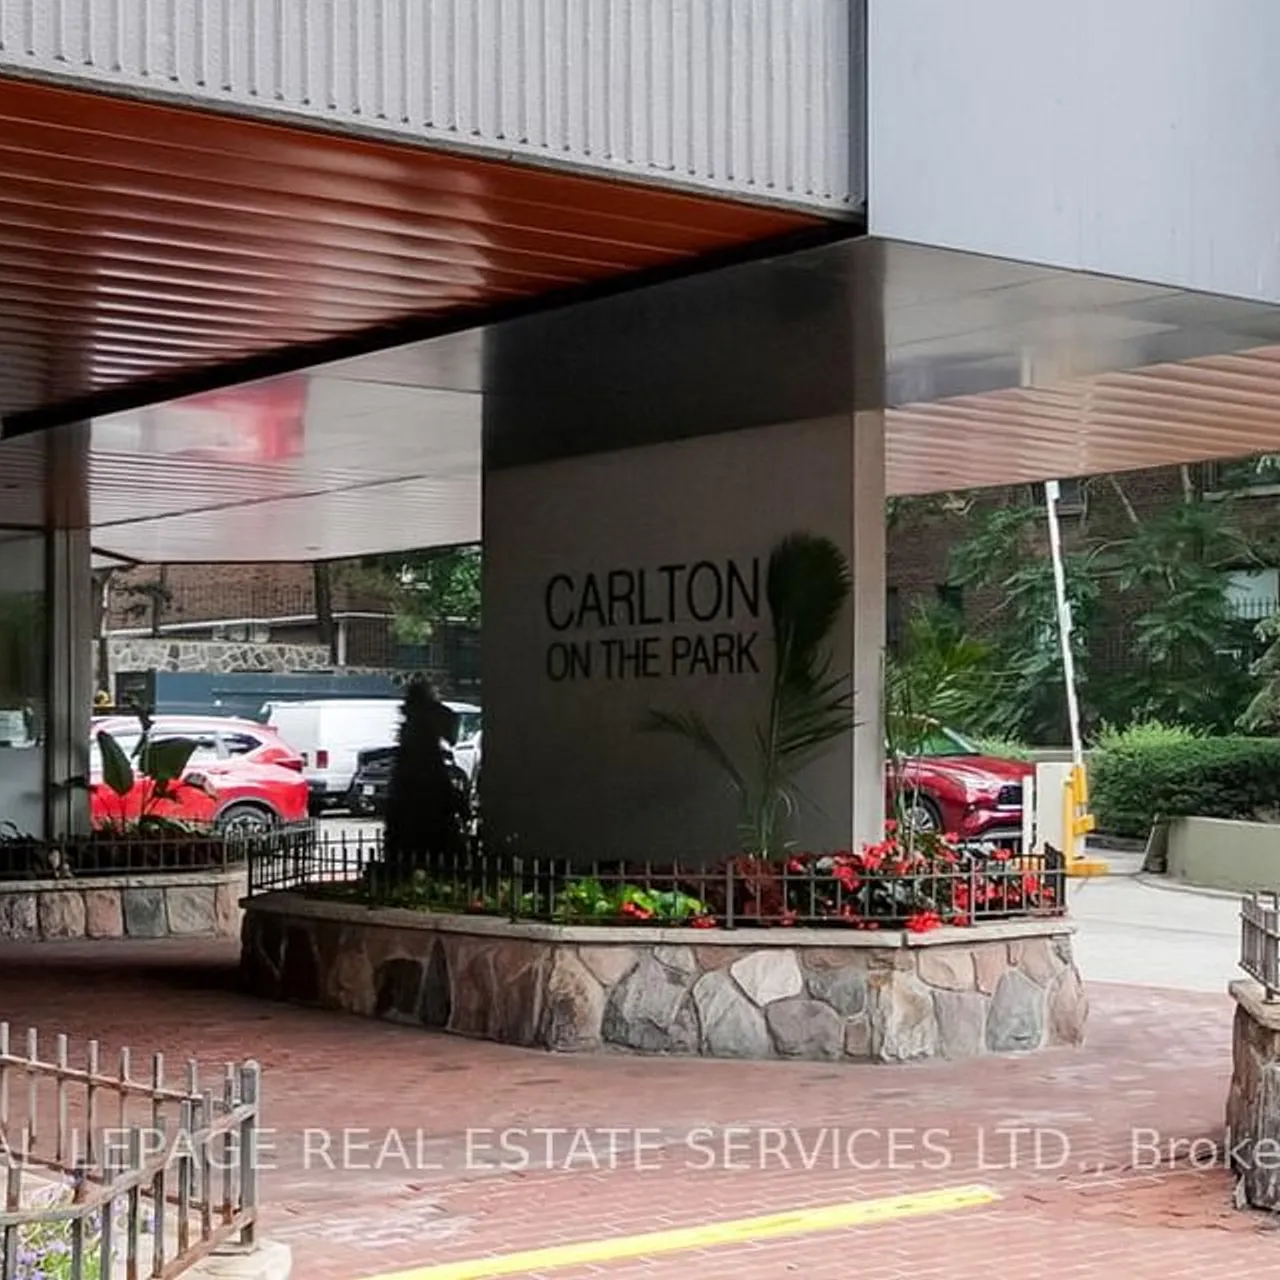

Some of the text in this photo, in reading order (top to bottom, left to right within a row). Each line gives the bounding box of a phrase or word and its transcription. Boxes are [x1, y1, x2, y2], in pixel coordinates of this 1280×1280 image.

[545, 557, 760, 631] CARLTON
[546, 631, 760, 682] ON THE PARK
